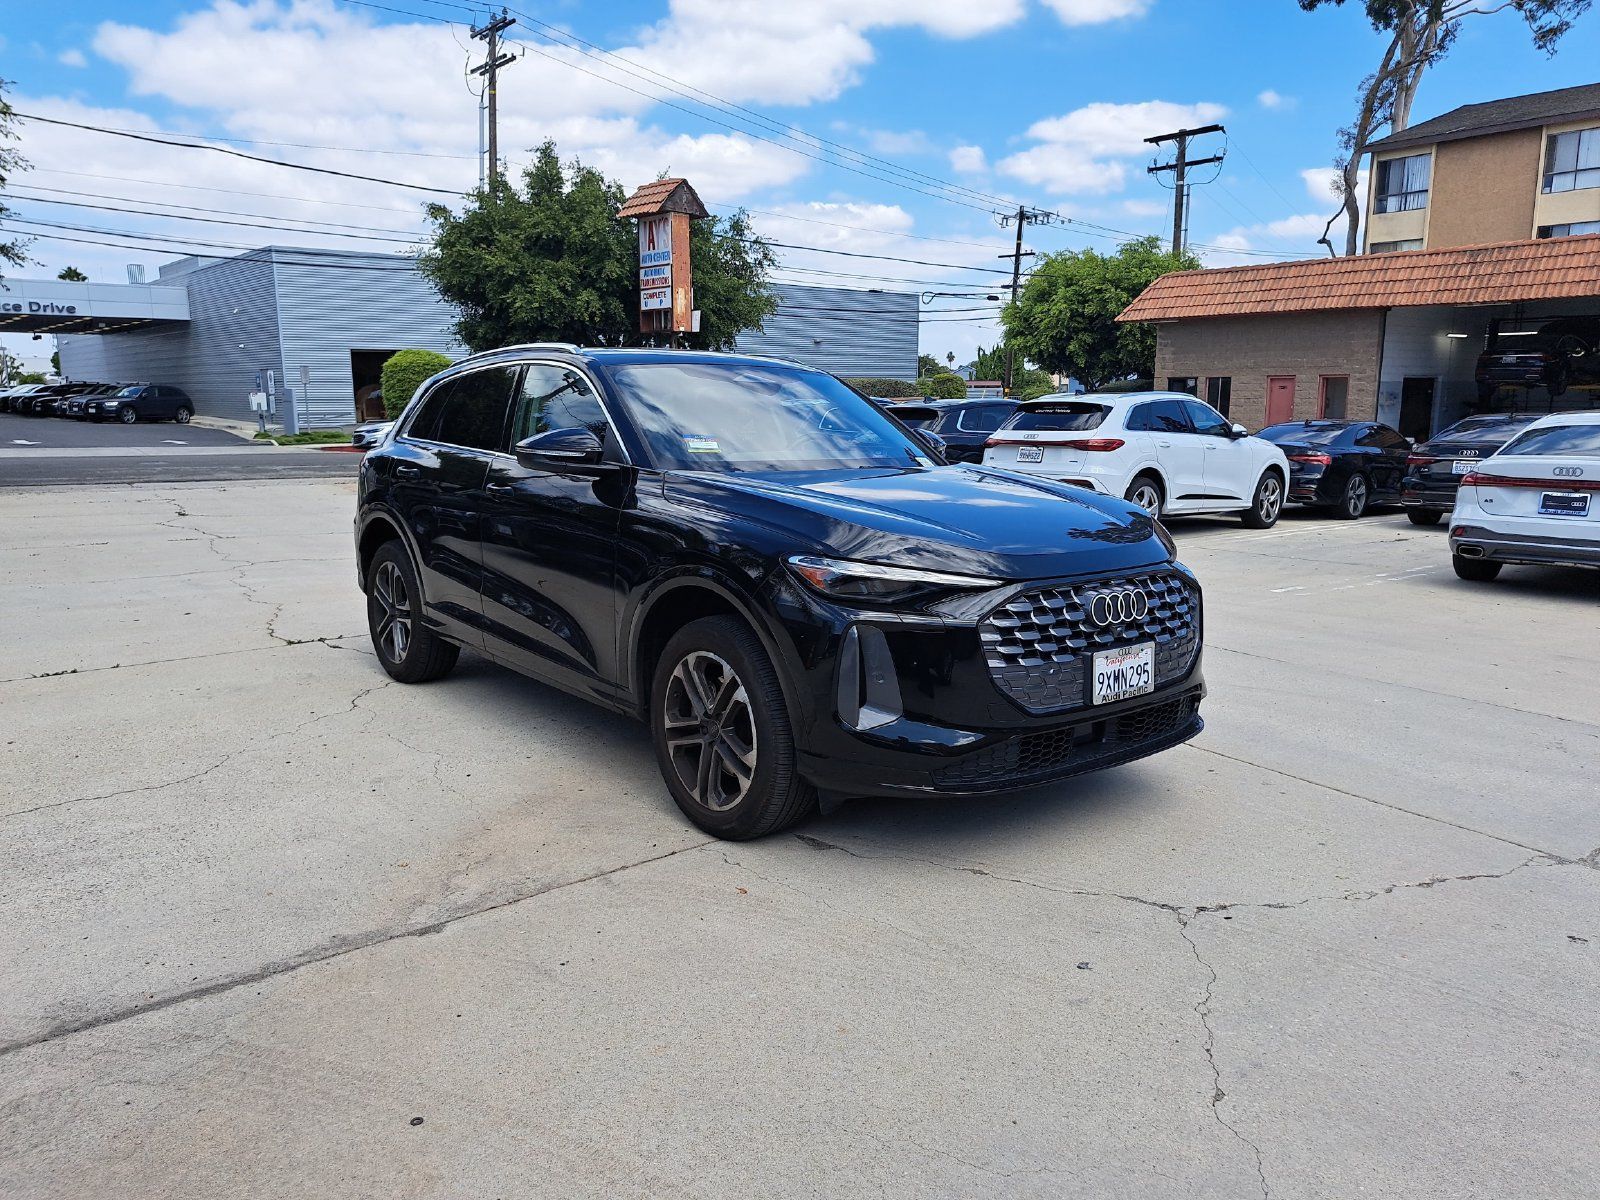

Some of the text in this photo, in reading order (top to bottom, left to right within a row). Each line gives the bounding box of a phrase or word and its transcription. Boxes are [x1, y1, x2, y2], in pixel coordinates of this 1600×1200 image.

[643, 290, 667, 300] COMPLETE
[0, 301, 77, 314] ce Drive
[1097, 661, 1150, 696] 9XMN295
[1101, 686, 1149, 704] Audi Pacific
